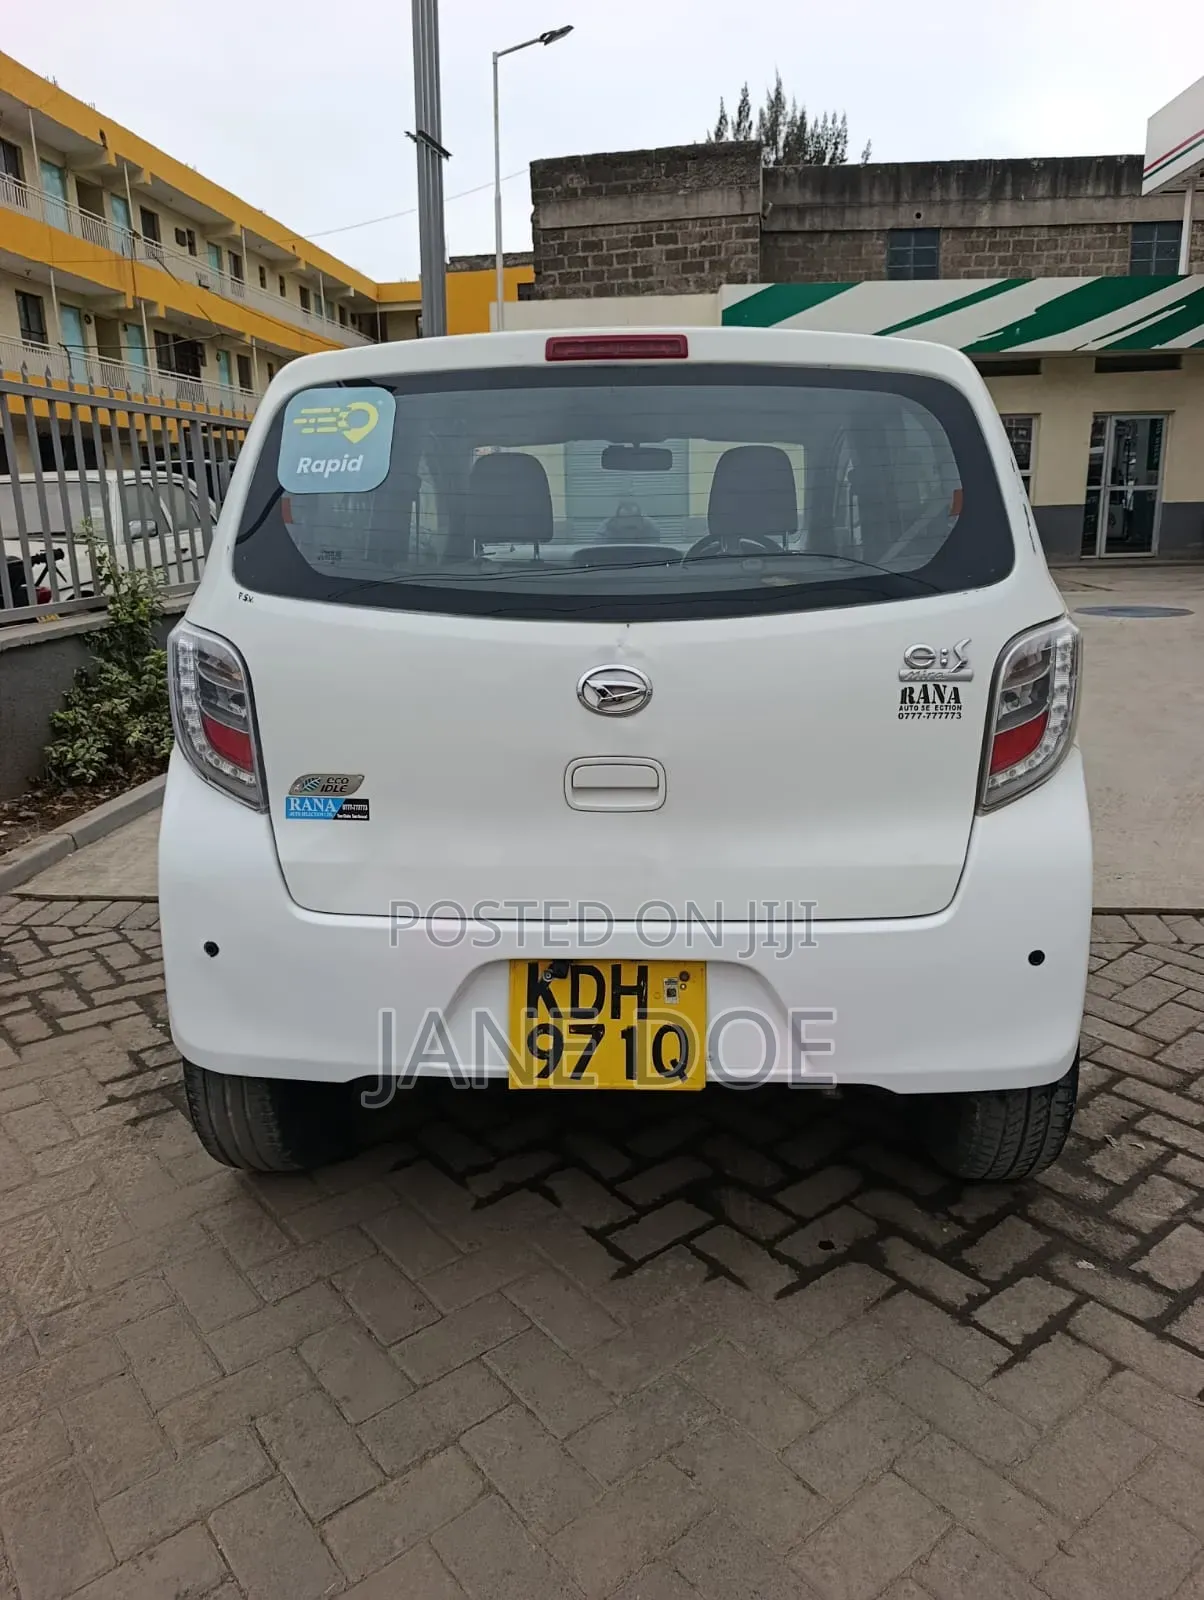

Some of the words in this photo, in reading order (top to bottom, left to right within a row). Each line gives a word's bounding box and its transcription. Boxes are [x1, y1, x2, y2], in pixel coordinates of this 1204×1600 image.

[296, 454, 364, 478] Rapid
[900, 683, 962, 704] RANA
[899, 704, 919, 712] AUTO
[898, 711, 962, 720] 0777-777773
[320, 784, 348, 793] IDLE
[289, 798, 337, 812] RANA
[527, 962, 648, 1020] KDH
